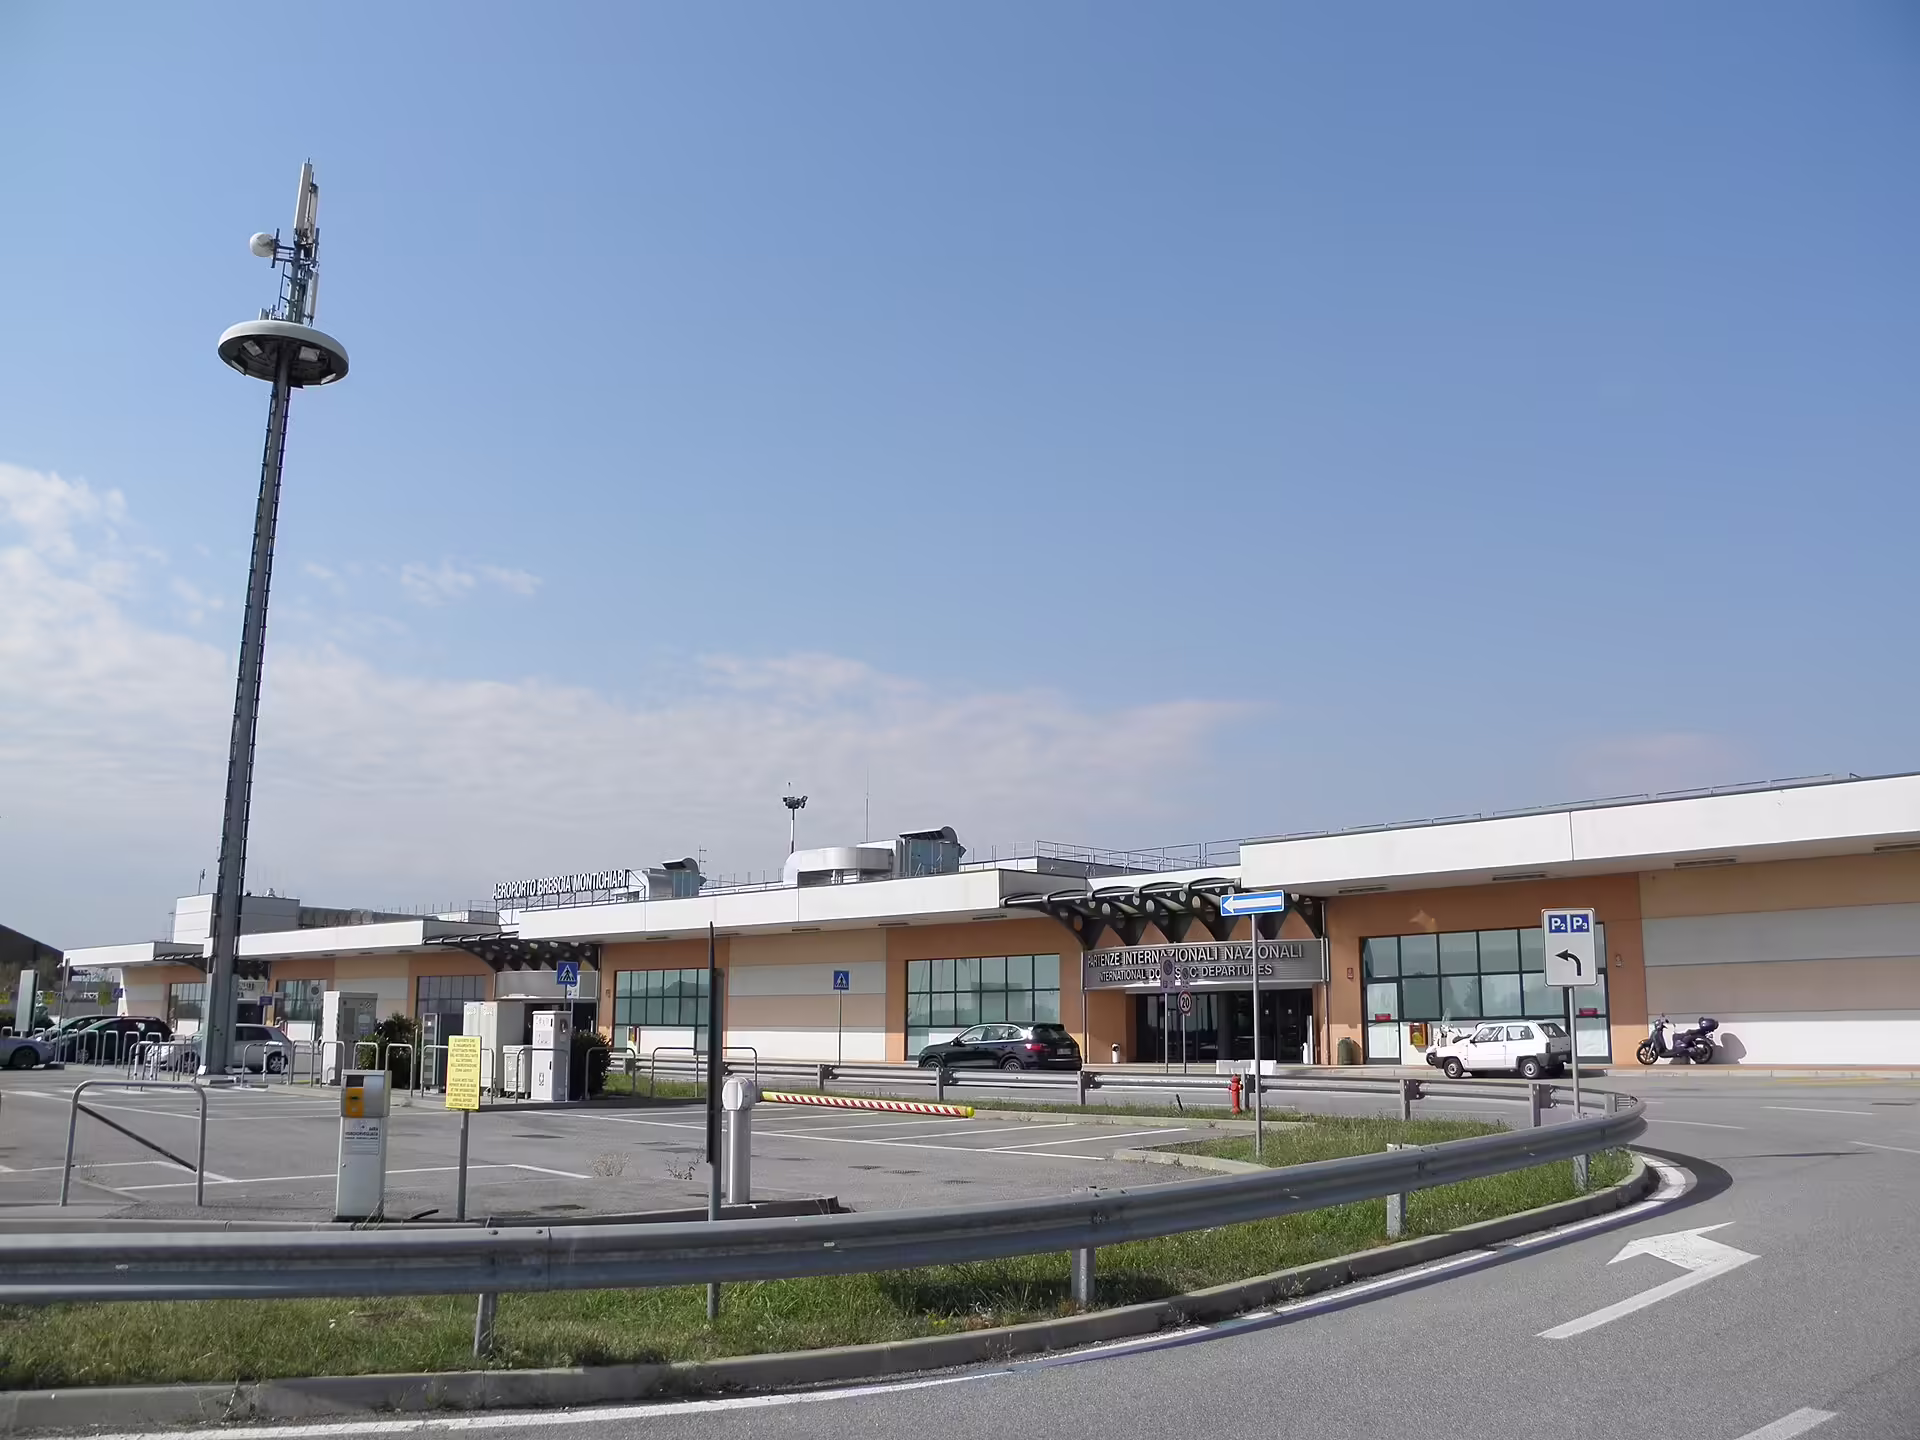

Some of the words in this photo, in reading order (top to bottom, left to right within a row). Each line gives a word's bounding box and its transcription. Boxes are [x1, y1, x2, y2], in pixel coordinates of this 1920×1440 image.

[492, 879, 537, 899] AEROPORTO
[538, 875, 572, 895] BRESCIA
[573, 870, 628, 891] MONTICHIARI
[1088, 952, 1120, 967] PARTENZE
[1224, 944, 1302, 960] NAZONALI
[1181, 996, 1190, 1009] 20
